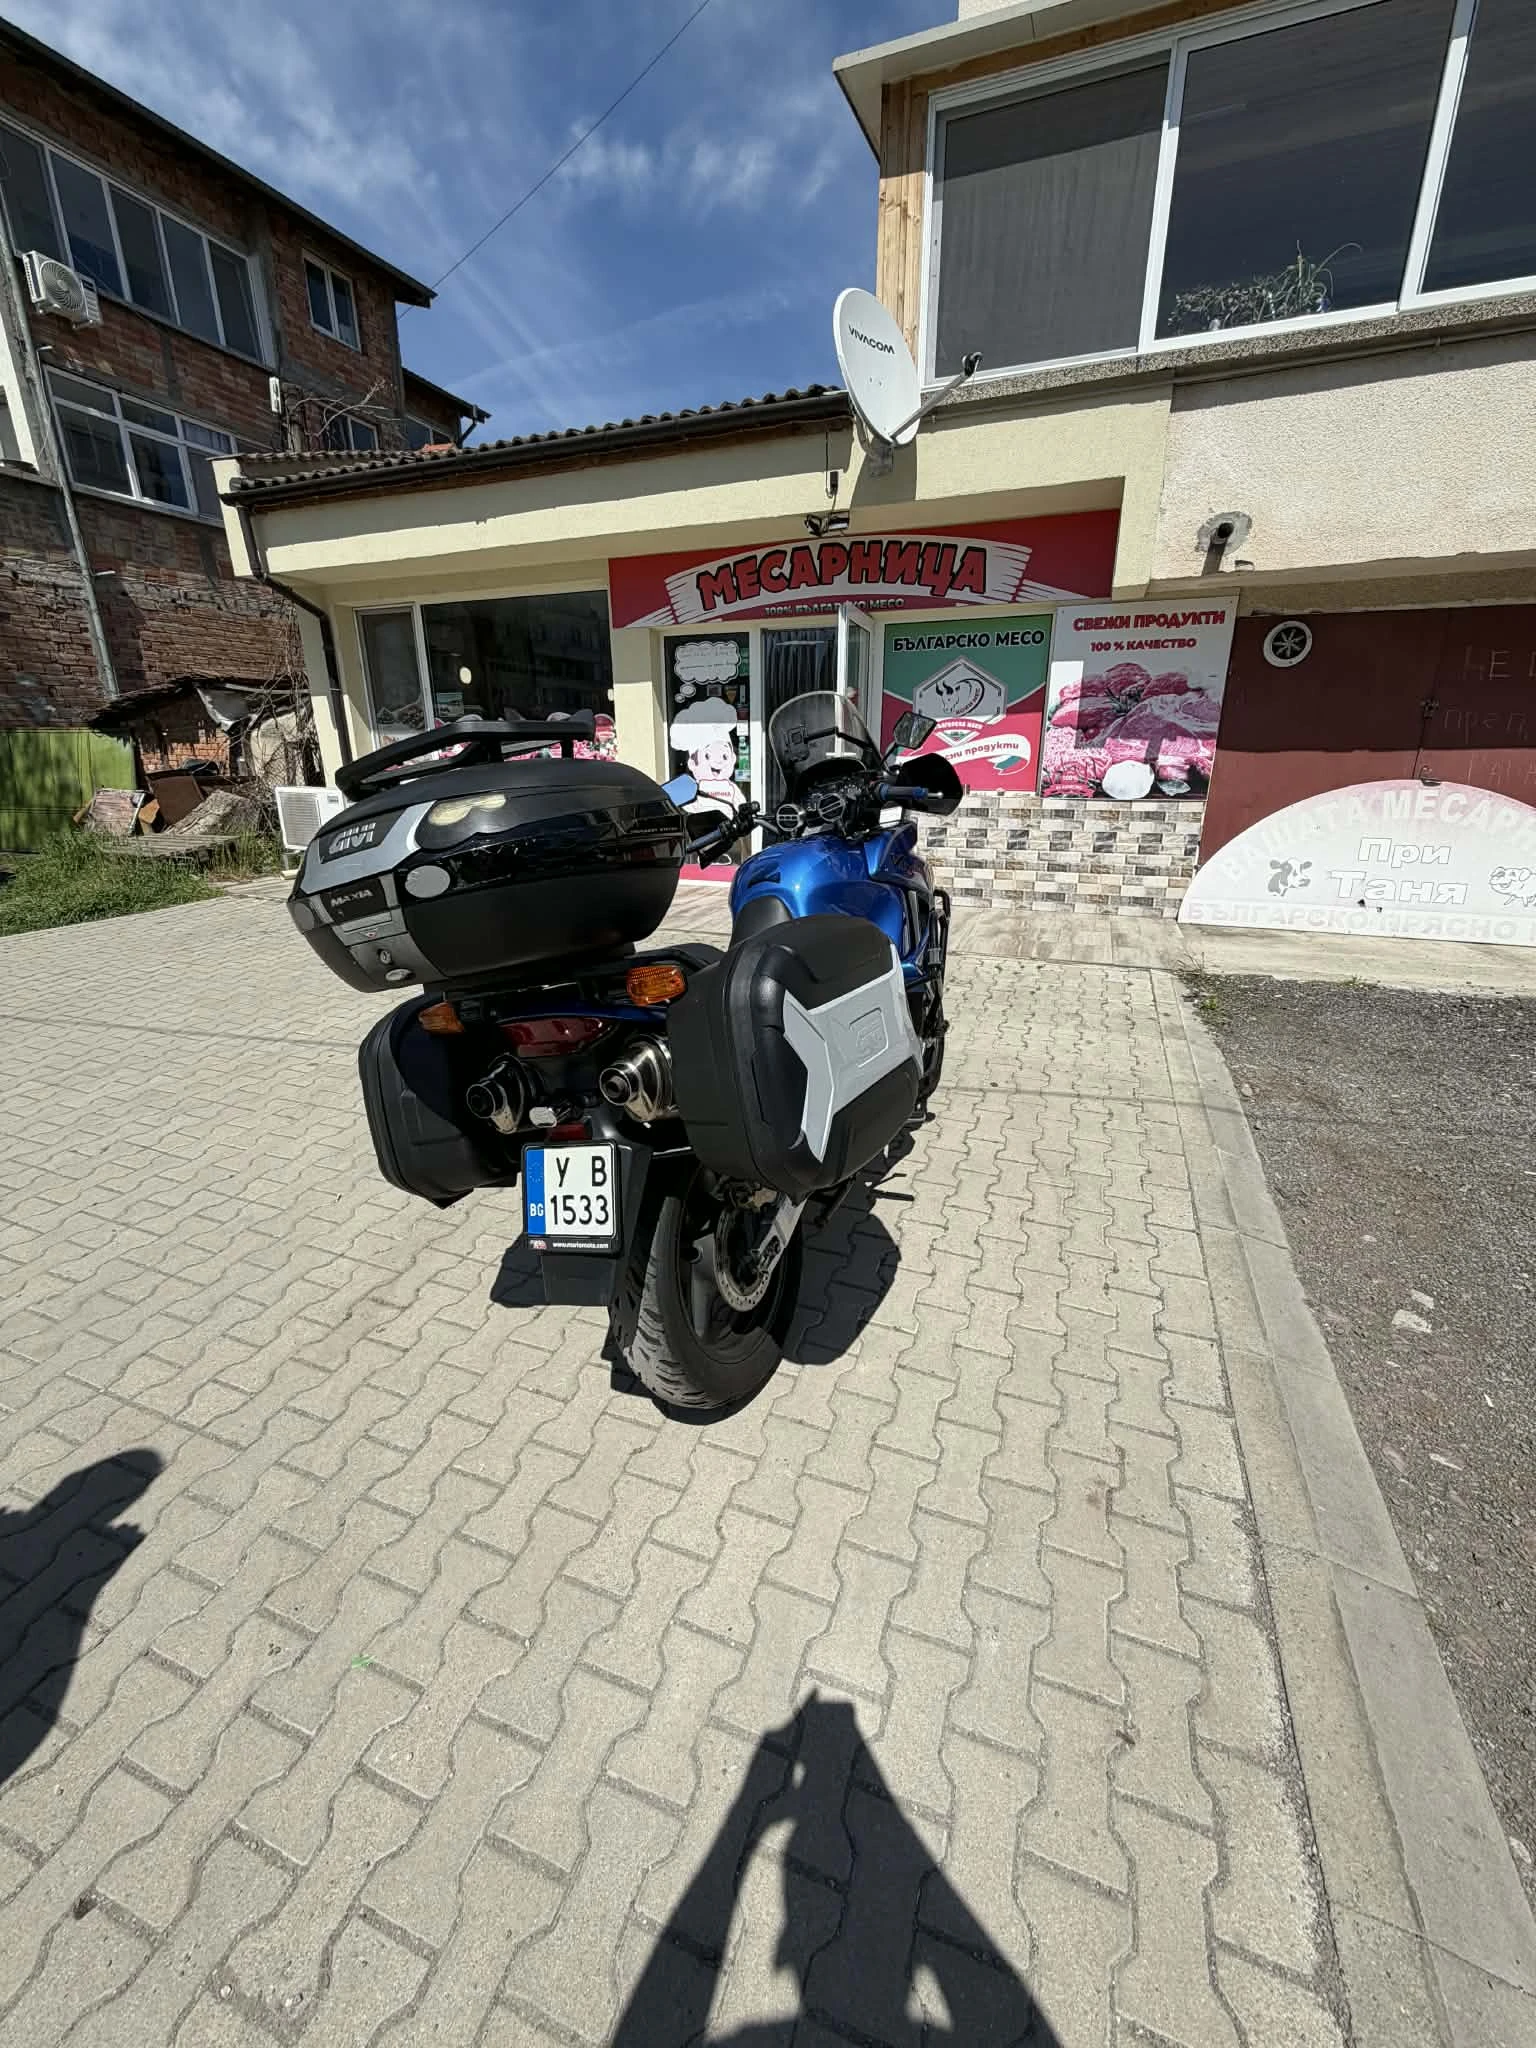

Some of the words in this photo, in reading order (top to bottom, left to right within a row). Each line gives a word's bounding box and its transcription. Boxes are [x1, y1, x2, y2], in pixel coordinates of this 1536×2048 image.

[848, 325, 895, 354] VIVACOM
[696, 540, 987, 611] МЕСАРНИЦА
[869, 598, 905, 610] МЕСО
[1073, 614, 1131, 631] СВЕЖИ
[1133, 610, 1226, 629] ПРОДУКТИ
[893, 633, 990, 651] БЪЛГАРСКО
[995, 630, 1045, 646] МЕСО
[1090, 641, 1111, 652] 100
[1114, 640, 1124, 651] %
[1126, 637, 1197, 651] КАЧЕСТВО
[964, 741, 1020, 756] продукти
[329, 822, 376, 854] GIVI
[1358, 836, 1452, 869] При
[330, 889, 374, 907] MAXIA
[1328, 870, 1469, 905] Таня
[529, 1203, 544, 1217] BG
[550, 1195, 609, 1226] 1533
